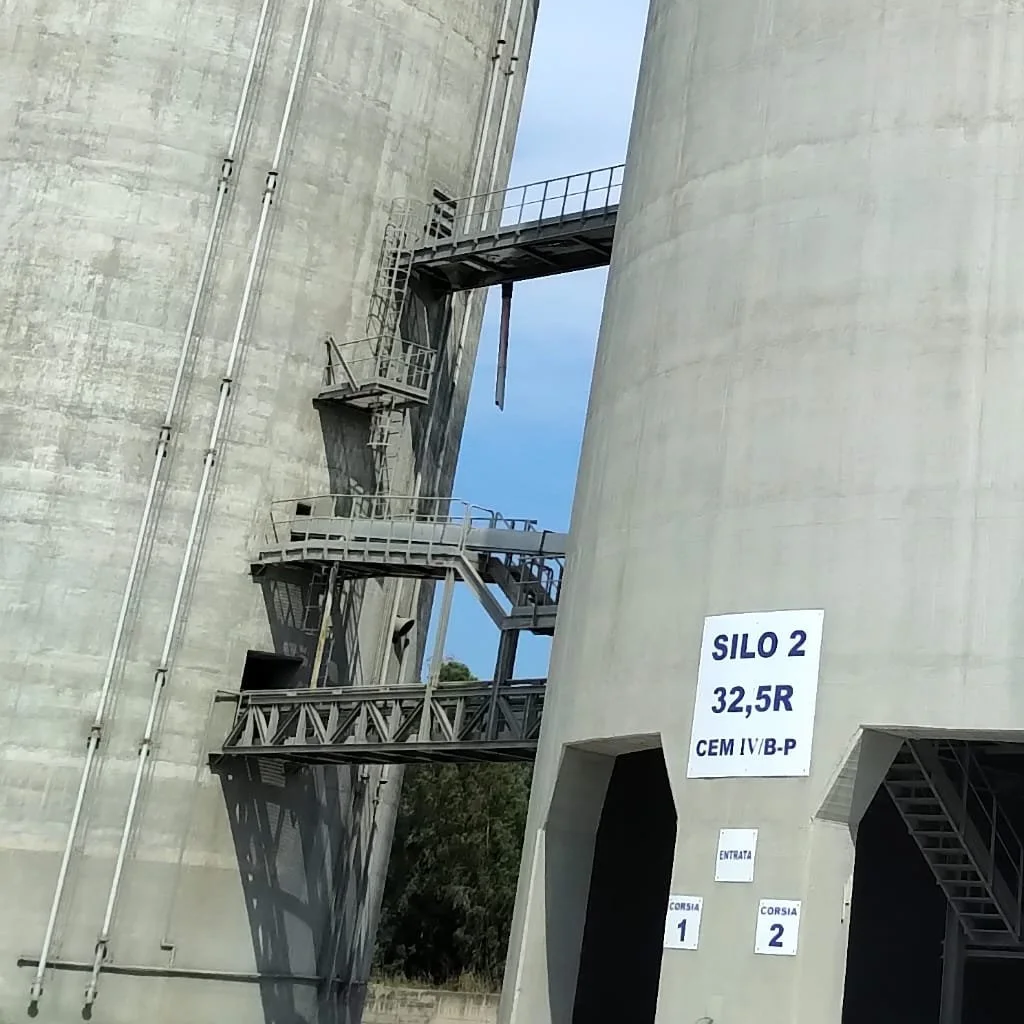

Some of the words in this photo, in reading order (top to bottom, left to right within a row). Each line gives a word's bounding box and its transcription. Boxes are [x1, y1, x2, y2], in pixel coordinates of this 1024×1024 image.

[712, 631, 778, 661] SILO
[788, 629, 807, 657] 2
[711, 684, 794, 719] 32,5R
[696, 738, 735, 757] CEM
[739, 737, 797, 756] IV/B-P
[719, 850, 752, 861] ENTRATA
[669, 901, 700, 912] CORSIA
[760, 906, 798, 916] CORSIA
[677, 918, 687, 942] 1
[768, 923, 785, 948] 2
